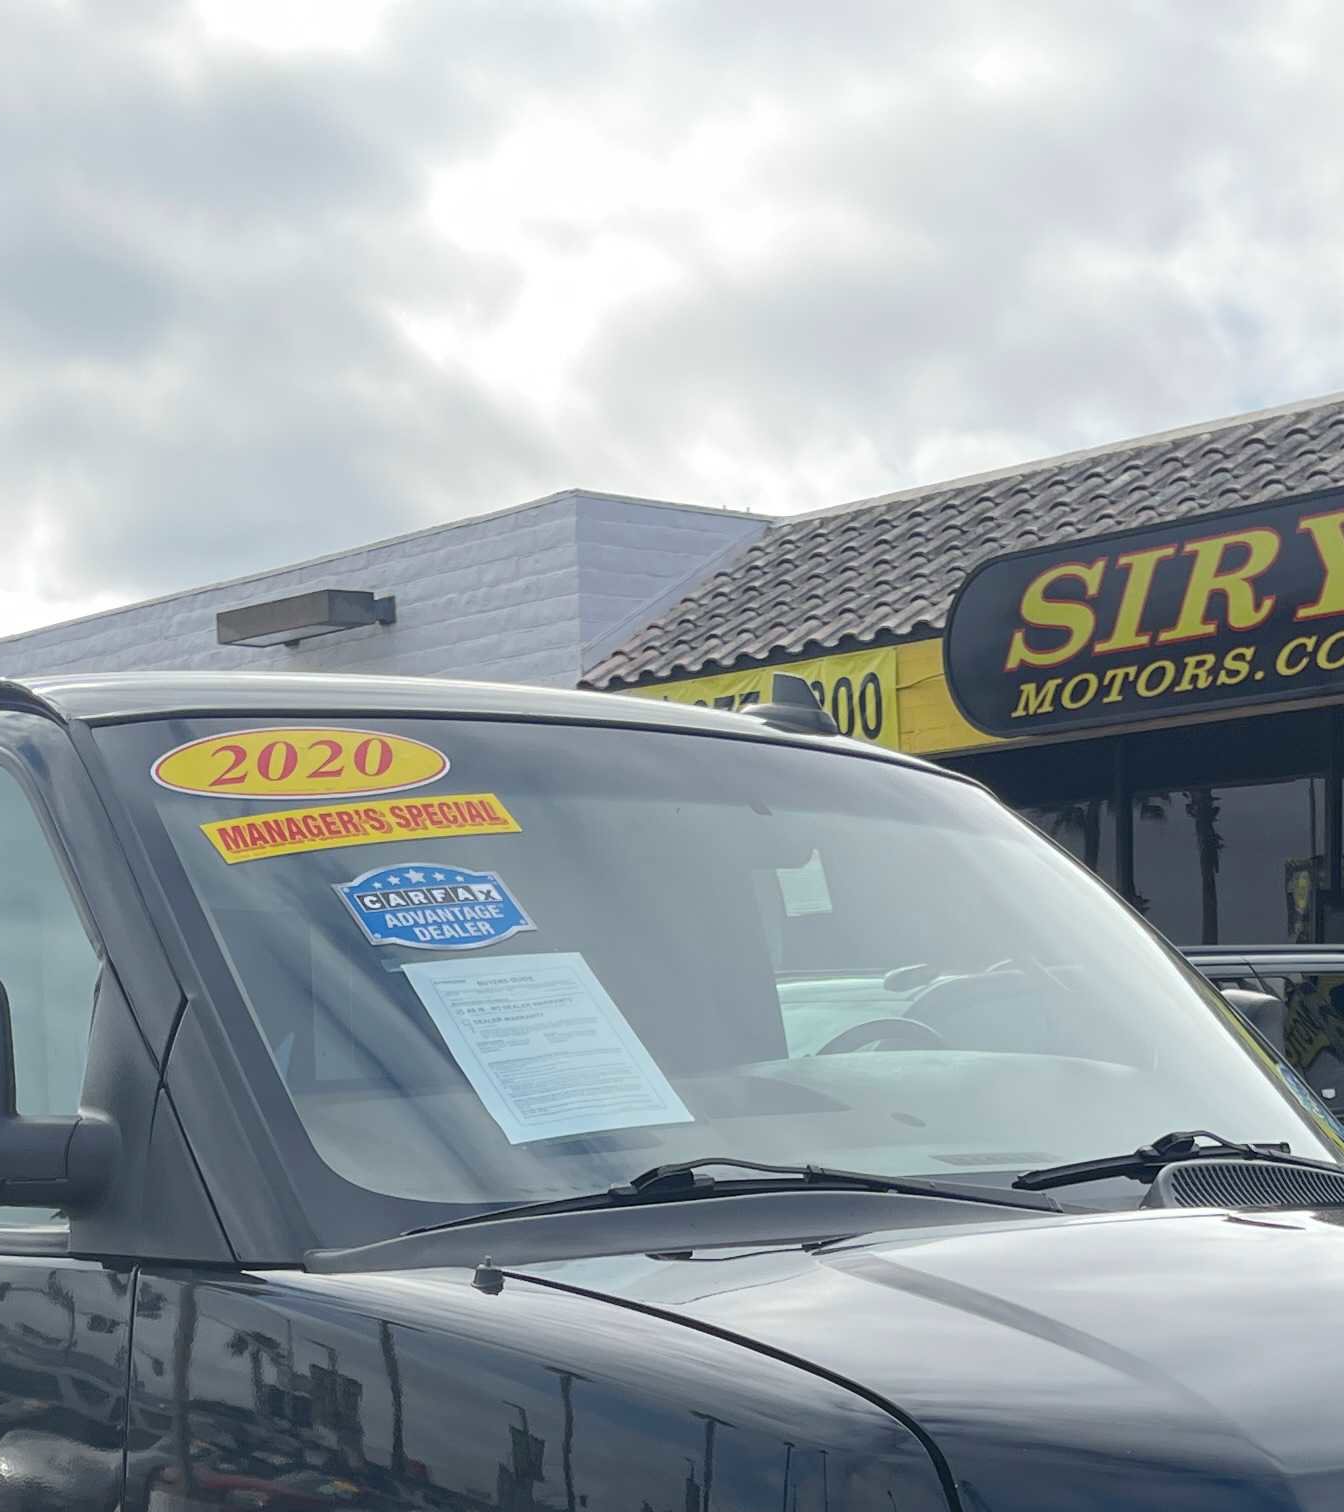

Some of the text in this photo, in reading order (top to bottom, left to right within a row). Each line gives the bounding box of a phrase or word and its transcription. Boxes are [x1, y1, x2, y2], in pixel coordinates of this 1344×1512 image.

[207, 737, 393, 787] 2020
[216, 799, 506, 854] MANAGER'S SPECIAL
[360, 885, 501, 911] CARFAX
[384, 905, 504, 929] ADVANTAGE
[413, 922, 495, 942] DEALER
